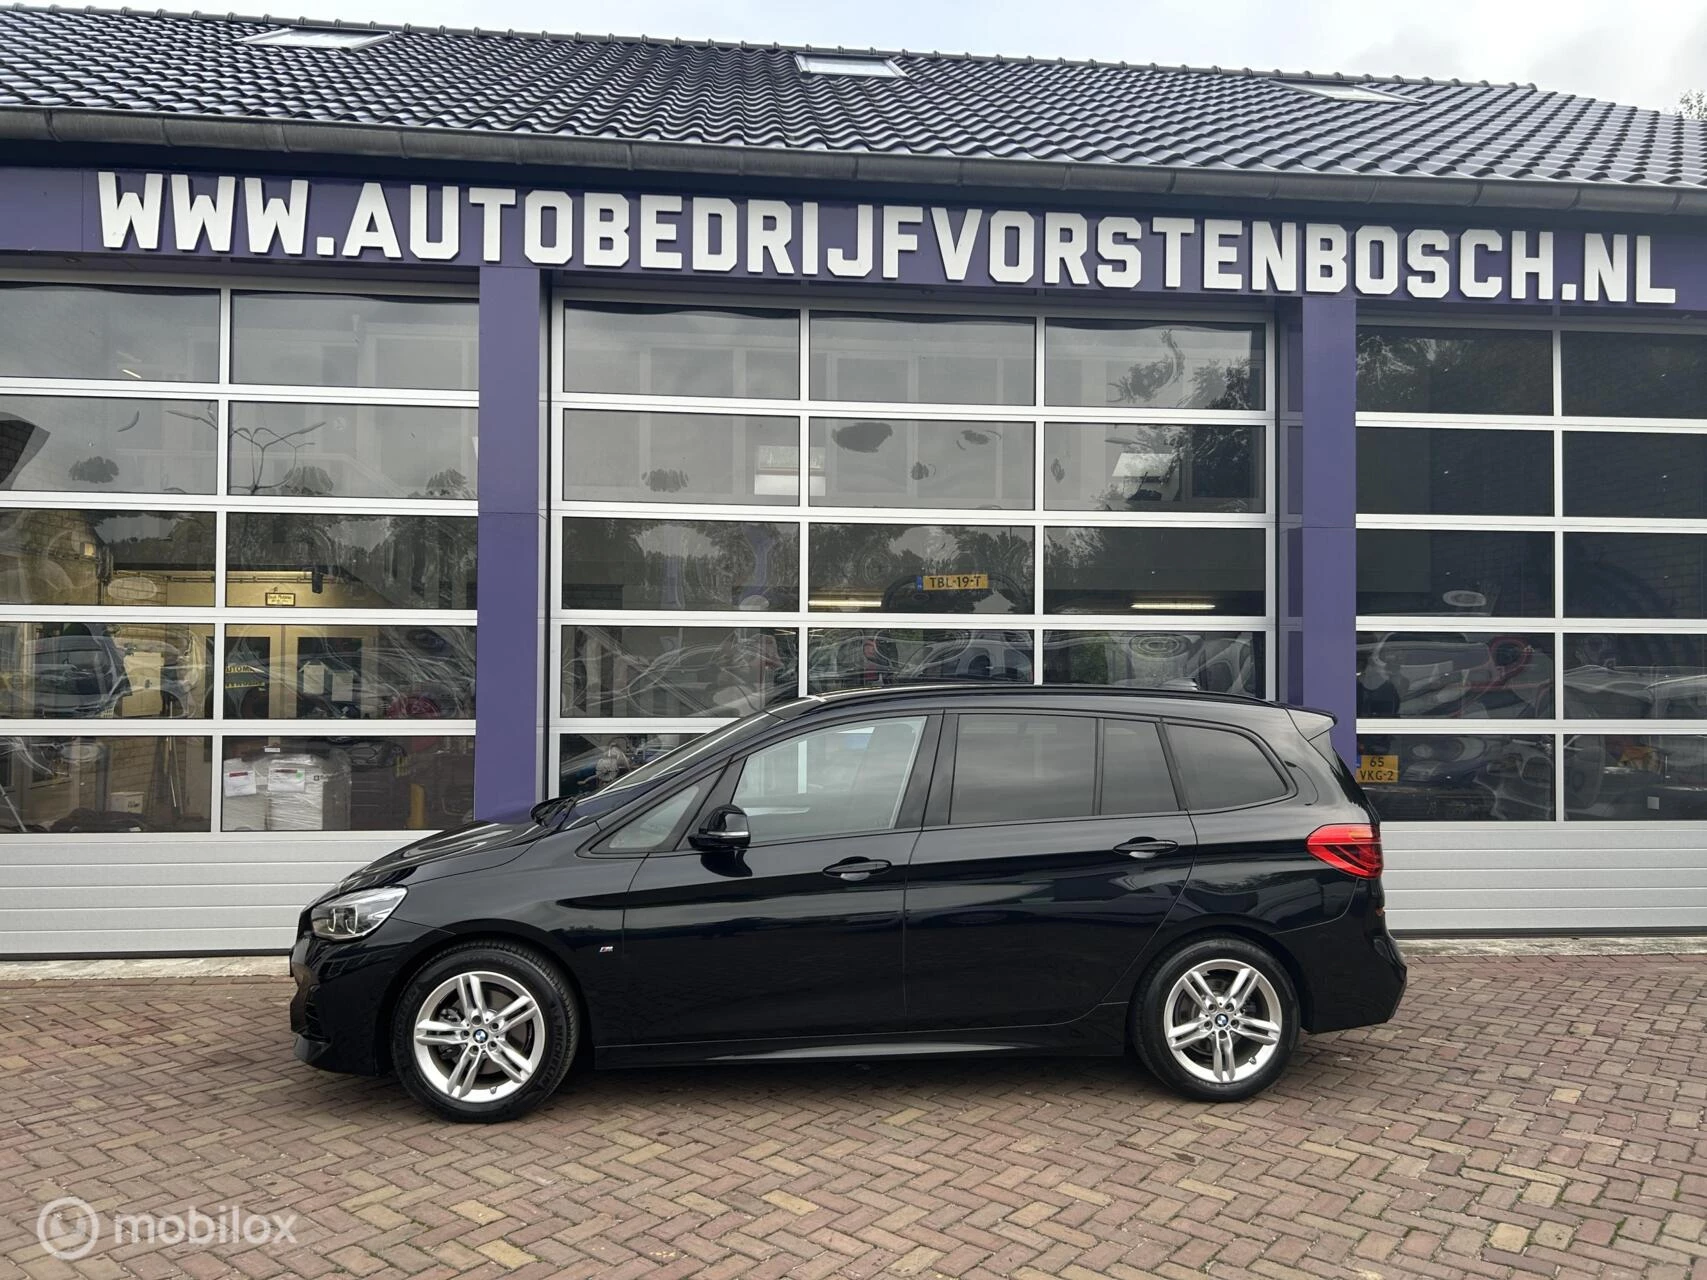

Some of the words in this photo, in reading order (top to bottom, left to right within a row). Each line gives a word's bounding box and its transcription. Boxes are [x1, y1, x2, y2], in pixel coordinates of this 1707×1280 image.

[98, 171, 1676, 304] WWW.AUTOBEDRIJFVORSTENBOSCH.NL
[929, 575, 982, 589] TBL-19-T
[1370, 756, 1385, 767] 65
[1360, 770, 1394, 781] VKG-2
